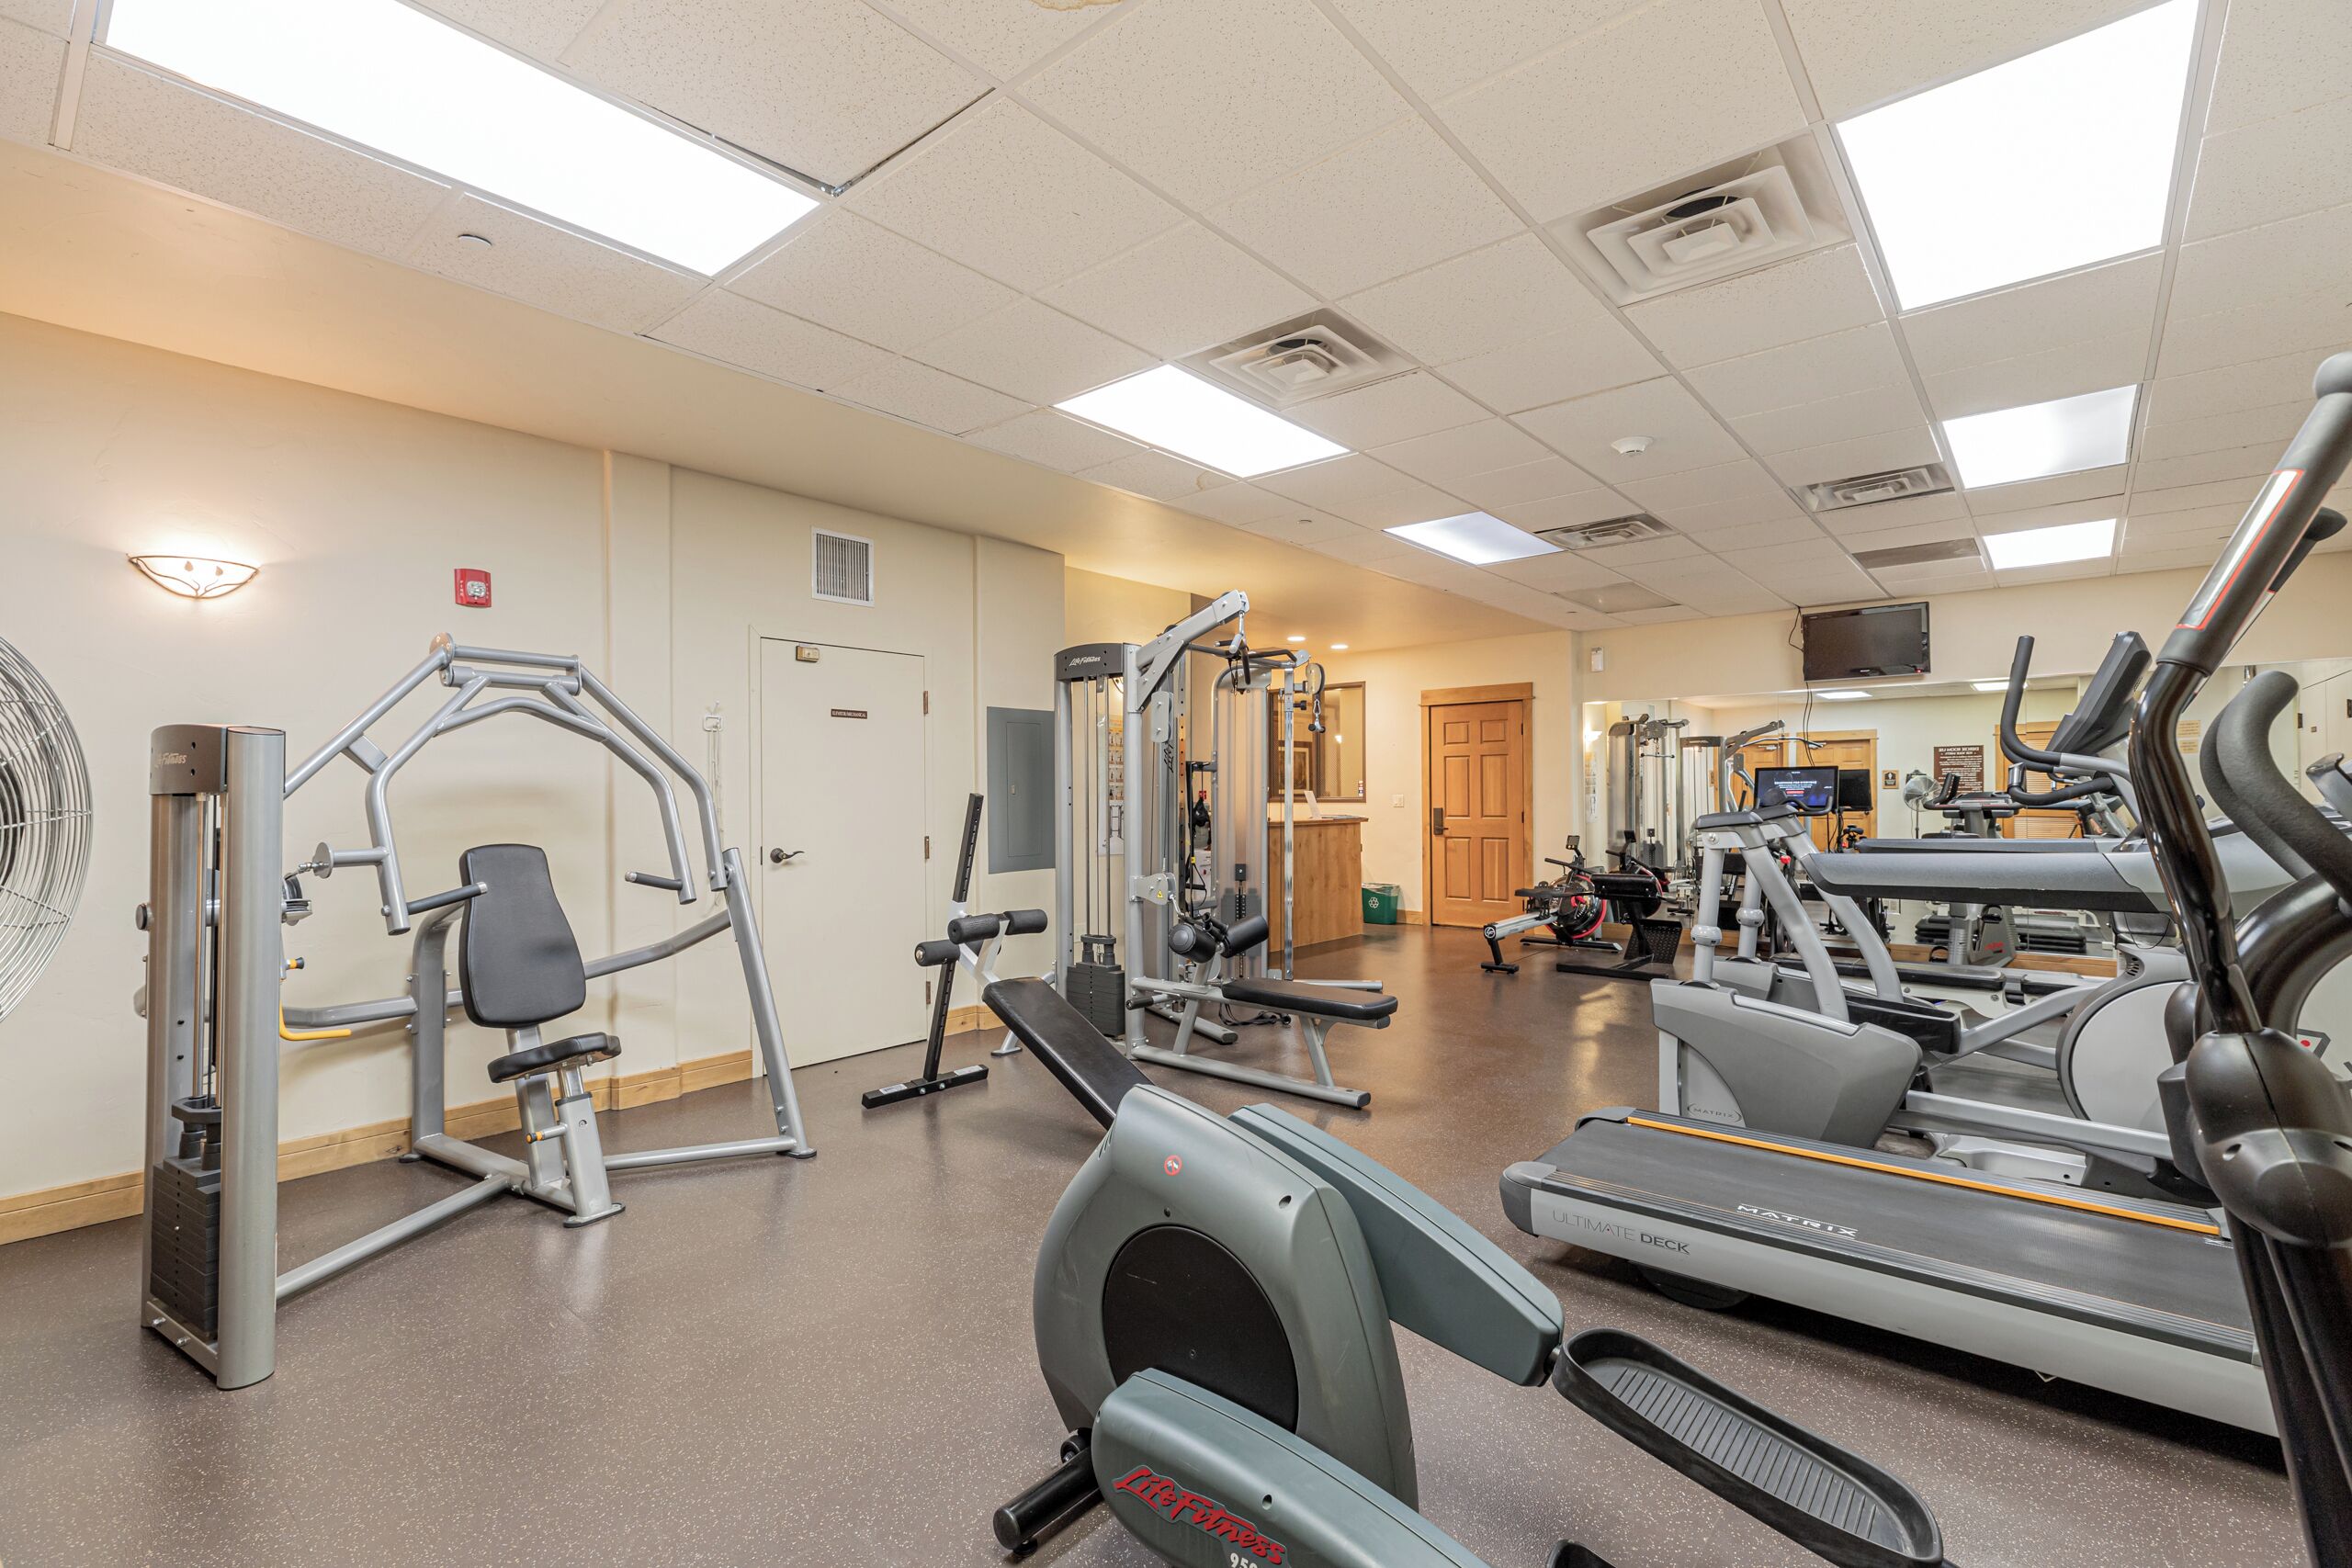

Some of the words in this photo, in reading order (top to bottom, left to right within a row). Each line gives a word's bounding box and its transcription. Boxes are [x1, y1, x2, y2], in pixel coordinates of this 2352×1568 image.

[1693, 1108, 1734, 1119] MATRIX
[1553, 1209, 1635, 1241] ULTIMATE
[1640, 1233, 1690, 1255] DECK
[1736, 1204, 1857, 1237] MATRIX
